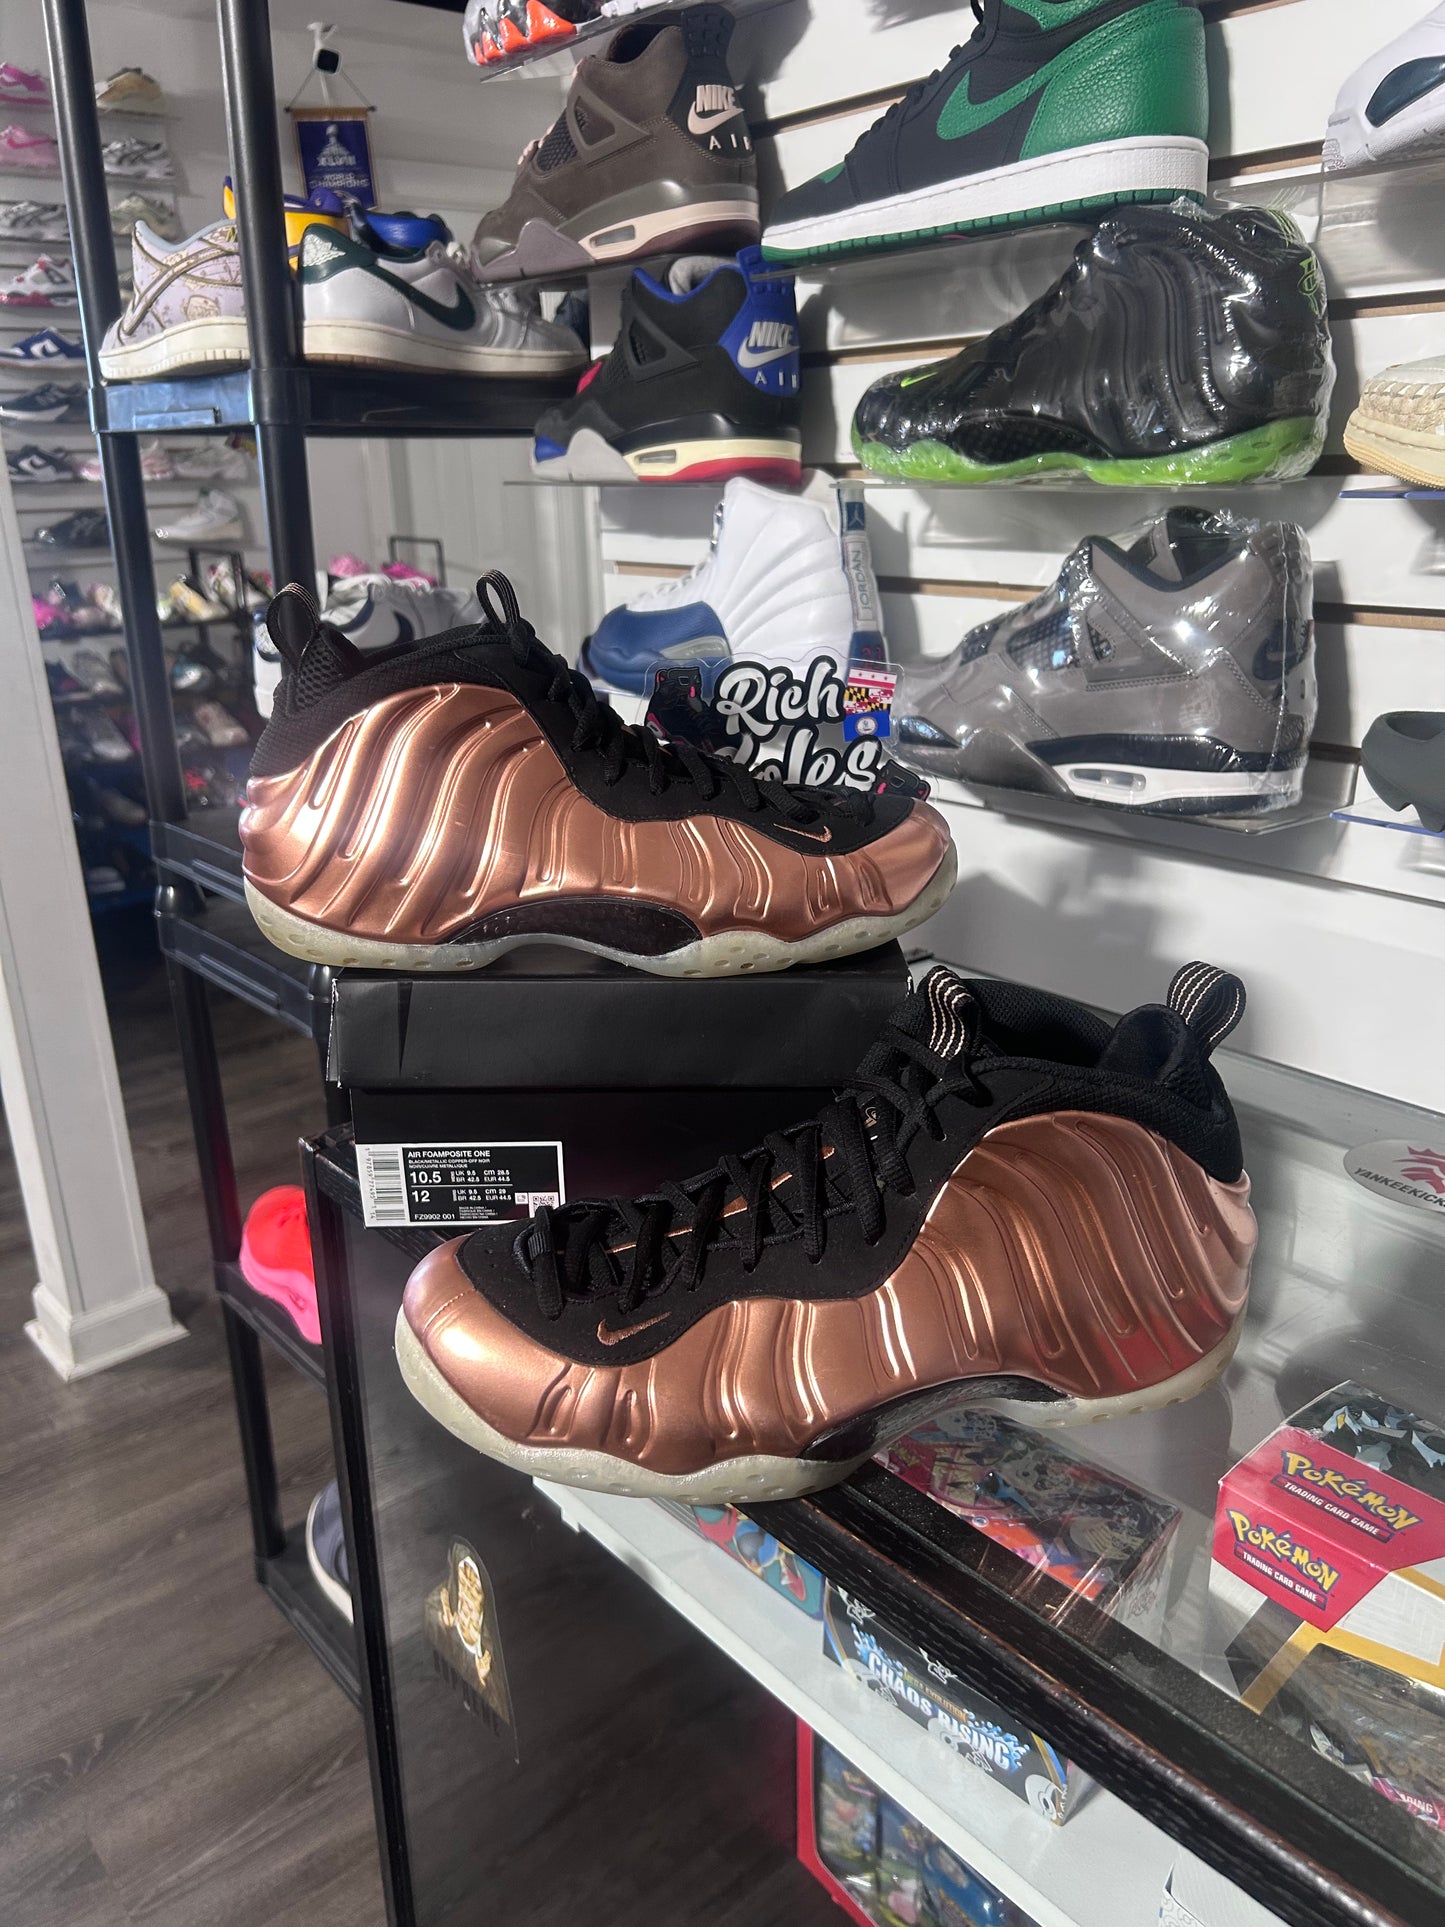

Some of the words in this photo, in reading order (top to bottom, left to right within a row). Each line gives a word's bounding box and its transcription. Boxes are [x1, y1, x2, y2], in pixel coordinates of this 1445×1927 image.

[696, 84, 737, 113] NIKE
[748, 321, 795, 348] NIKE
[852, 549, 872, 610] JORDAN
[716, 661, 840, 737] Rich
[422, 1150, 472, 1158] FOAMPOSITE
[410, 1171, 442, 1184] 10.5
[411, 1190, 431, 1203] 12
[1283, 1481, 1323, 1506] TRADING
[1324, 1502, 1351, 1521] CARD
[1351, 1516, 1380, 1536] GAME
[1242, 1551, 1273, 1576] TRADING
[1274, 1570, 1294, 1589] CARD
[1295, 1583, 1318, 1602] GAME
[868, 1651, 933, 1716] CHAOS
